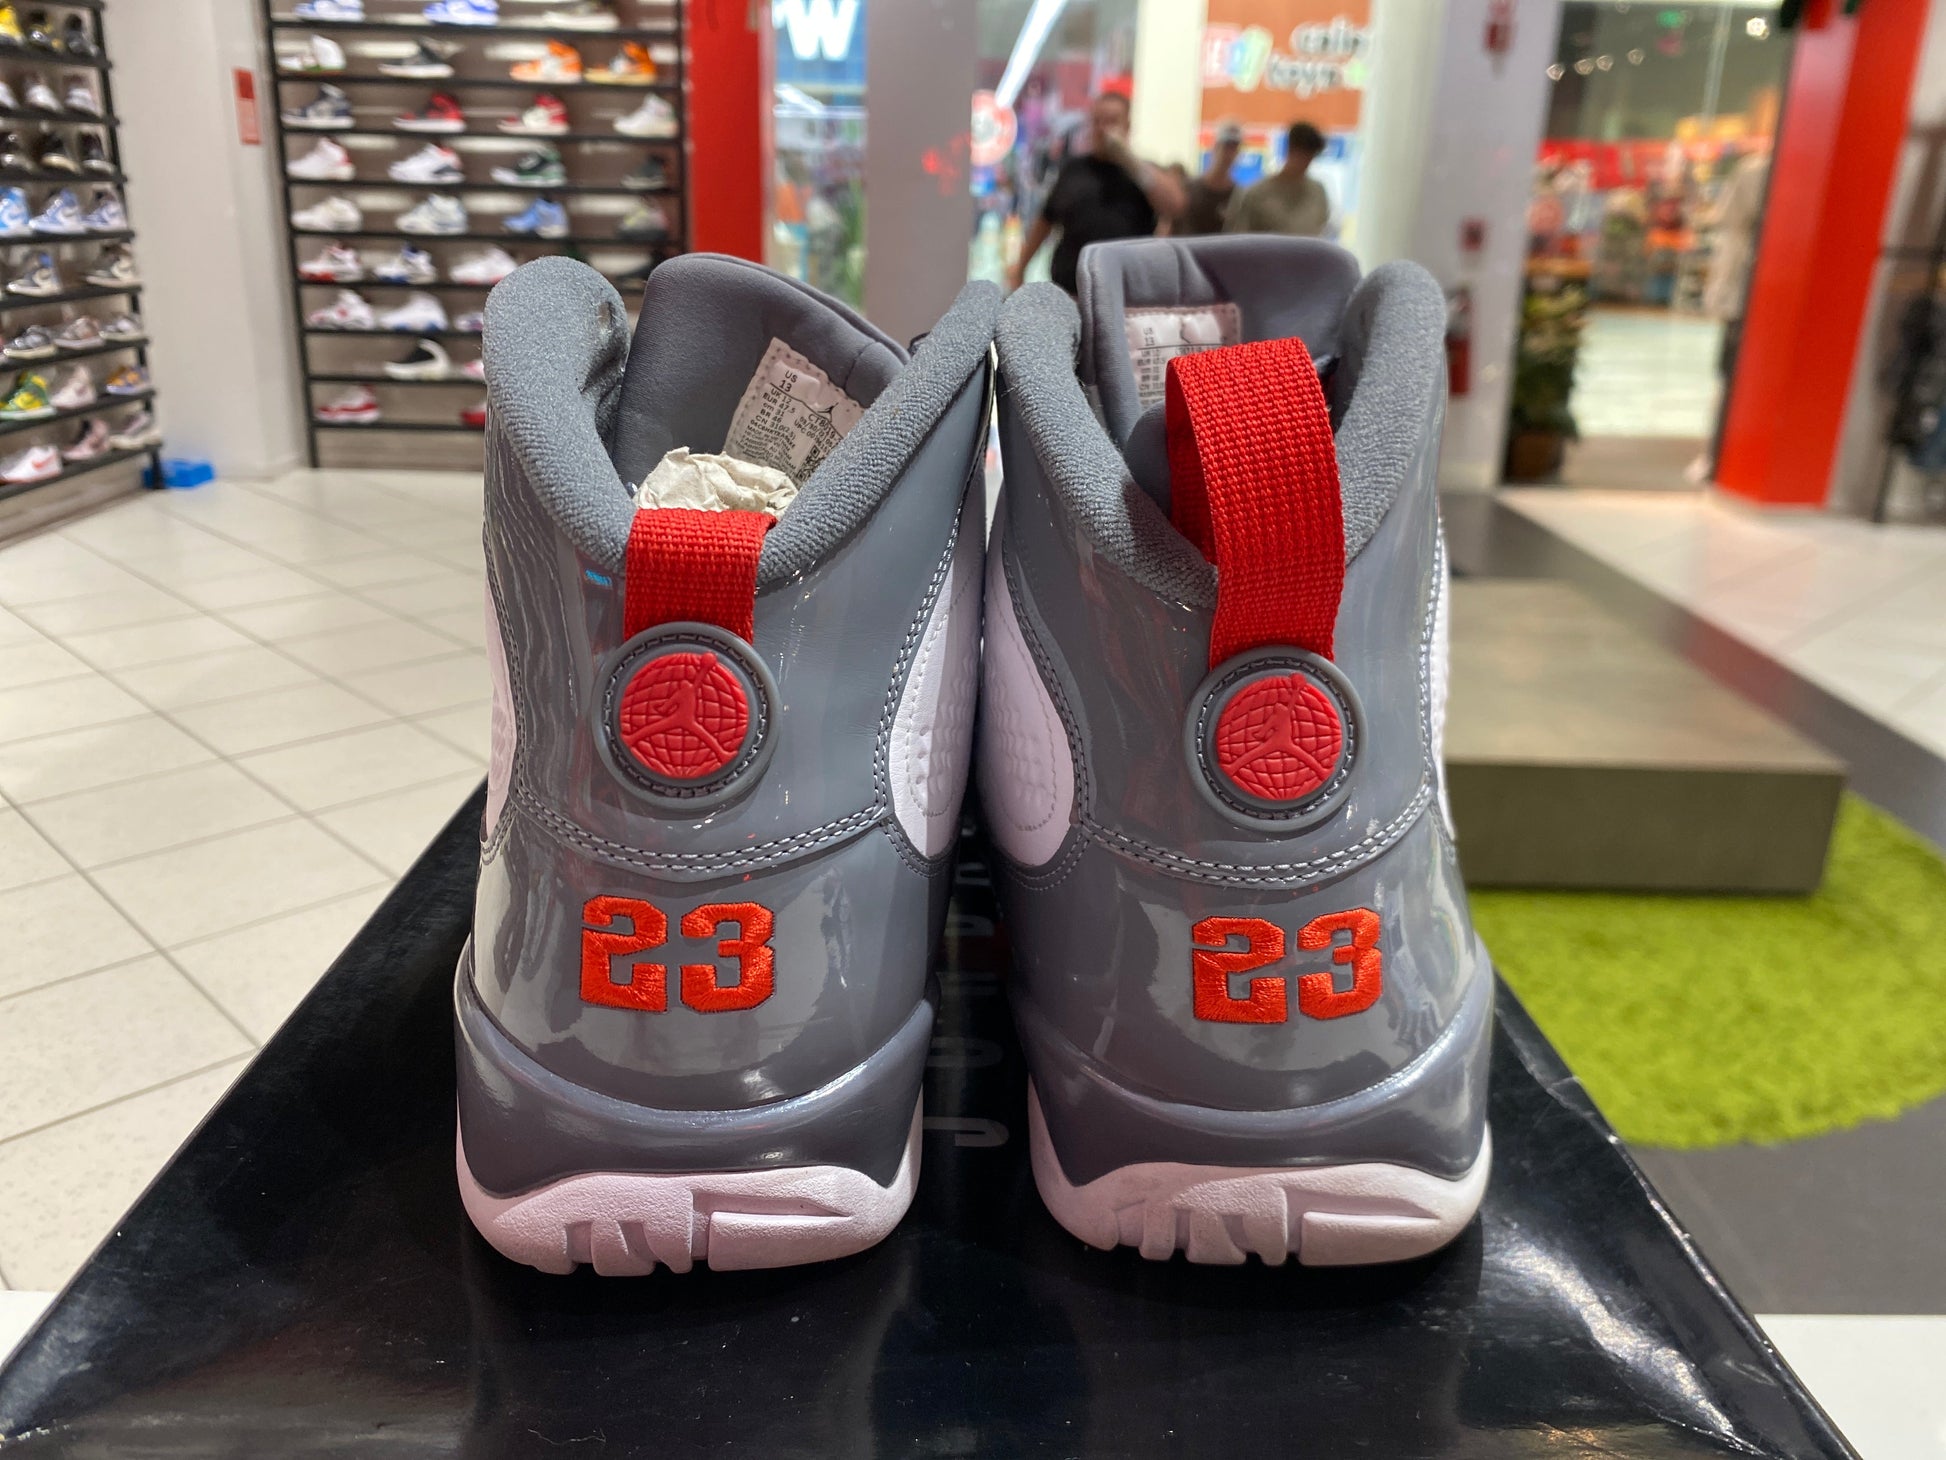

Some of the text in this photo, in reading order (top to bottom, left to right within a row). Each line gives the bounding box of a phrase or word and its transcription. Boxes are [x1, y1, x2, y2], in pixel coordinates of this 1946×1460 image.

[785, 370, 798, 383] US
[779, 380, 792, 392] 13
[762, 392, 778, 404] EUR
[771, 388, 792, 404] UK 12
[760, 408, 771, 418] BR
[755, 415, 768, 425] CN
[580, 894, 775, 1013] 23
[1191, 907, 1382, 1024] 23
